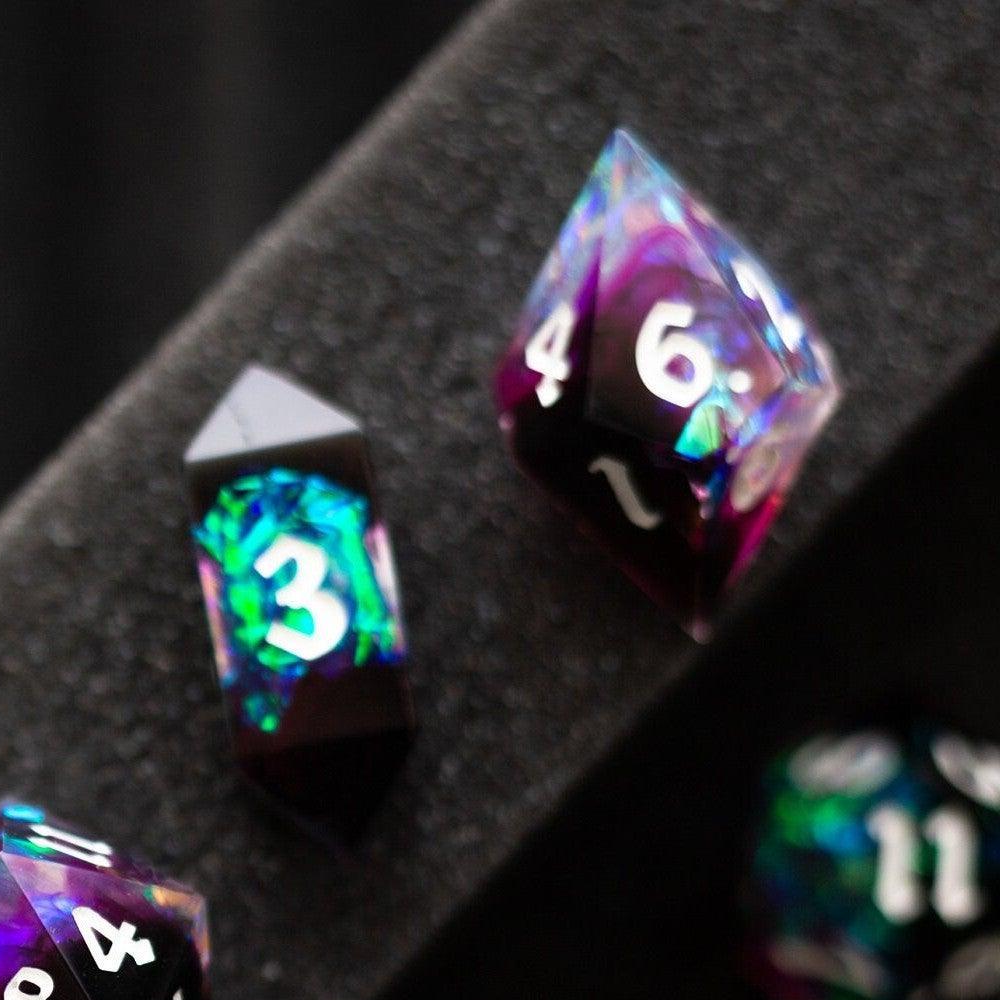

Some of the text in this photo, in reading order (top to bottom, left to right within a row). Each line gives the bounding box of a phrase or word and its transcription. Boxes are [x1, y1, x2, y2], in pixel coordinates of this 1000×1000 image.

[525, 302, 577, 408] 4
[254, 532, 349, 662] 3
[865, 803, 980, 927] 11
[72, 905, 156, 973] 4
